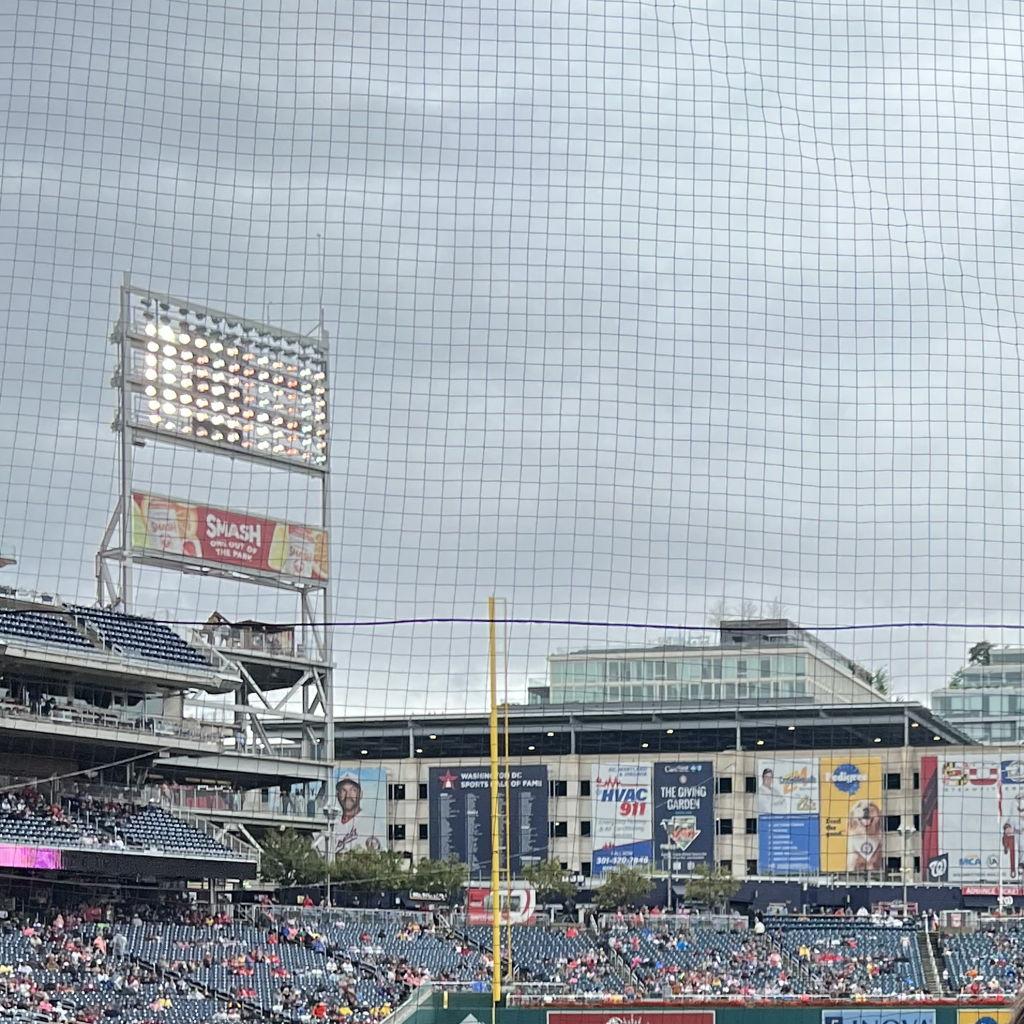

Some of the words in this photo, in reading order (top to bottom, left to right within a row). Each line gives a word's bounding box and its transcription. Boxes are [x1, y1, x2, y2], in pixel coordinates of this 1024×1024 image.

[206, 513, 261, 548] SMASH
[228, 541, 244, 550] OUT
[215, 547, 231, 557] THE
[232, 549, 254, 561] PARK
[510, 780, 521, 788] OF
[826, 771, 868, 784] Pedigree
[601, 788, 648, 802] HVAC
[661, 786, 677, 798] THE
[677, 785, 707, 798] GIVING
[620, 801, 647, 816] 911
[667, 798, 701, 811] GARDEN
[965, 885, 996, 895] ADVANCE
